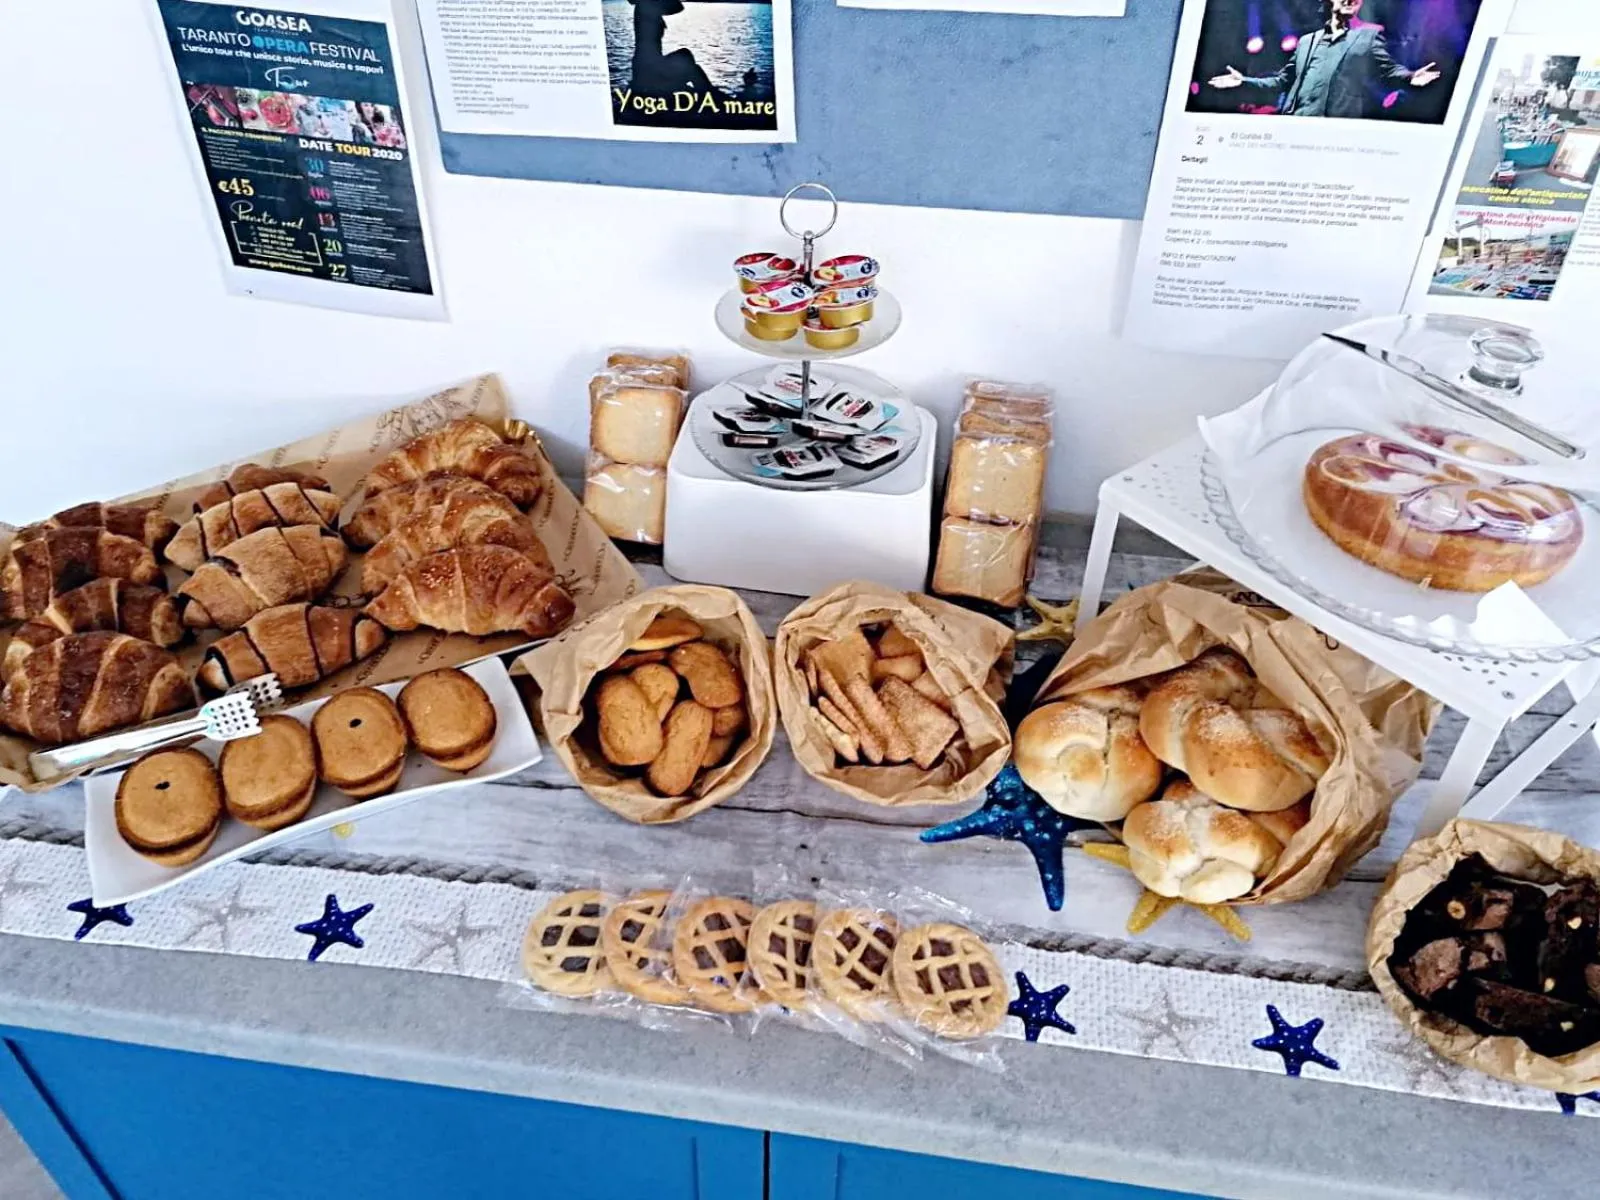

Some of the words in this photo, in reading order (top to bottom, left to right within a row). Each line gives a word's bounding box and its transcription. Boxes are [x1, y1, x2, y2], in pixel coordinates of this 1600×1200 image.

[236, 10, 312, 33] GO4SEA
[177, 27, 251, 47] TARANTO
[252, 35, 309, 54] OPERA
[309, 41, 381, 62] FESTIVAL
[182, 44, 213, 54] L'unico
[215, 47, 234, 56] tour
[235, 49, 251, 58] che
[253, 52, 282, 62] unisce
[313, 59, 346, 69] musica
[355, 64, 384, 75] sapori
[614, 88, 668, 114] Yoga
[299, 138, 334, 152] DATE
[335, 143, 371, 157] TOUR
[371, 148, 403, 161] 2020
[1195, 134, 1204, 146] 2
[217, 177, 254, 196] €45
[323, 239, 342, 253] 20
[328, 263, 347, 277] 27
